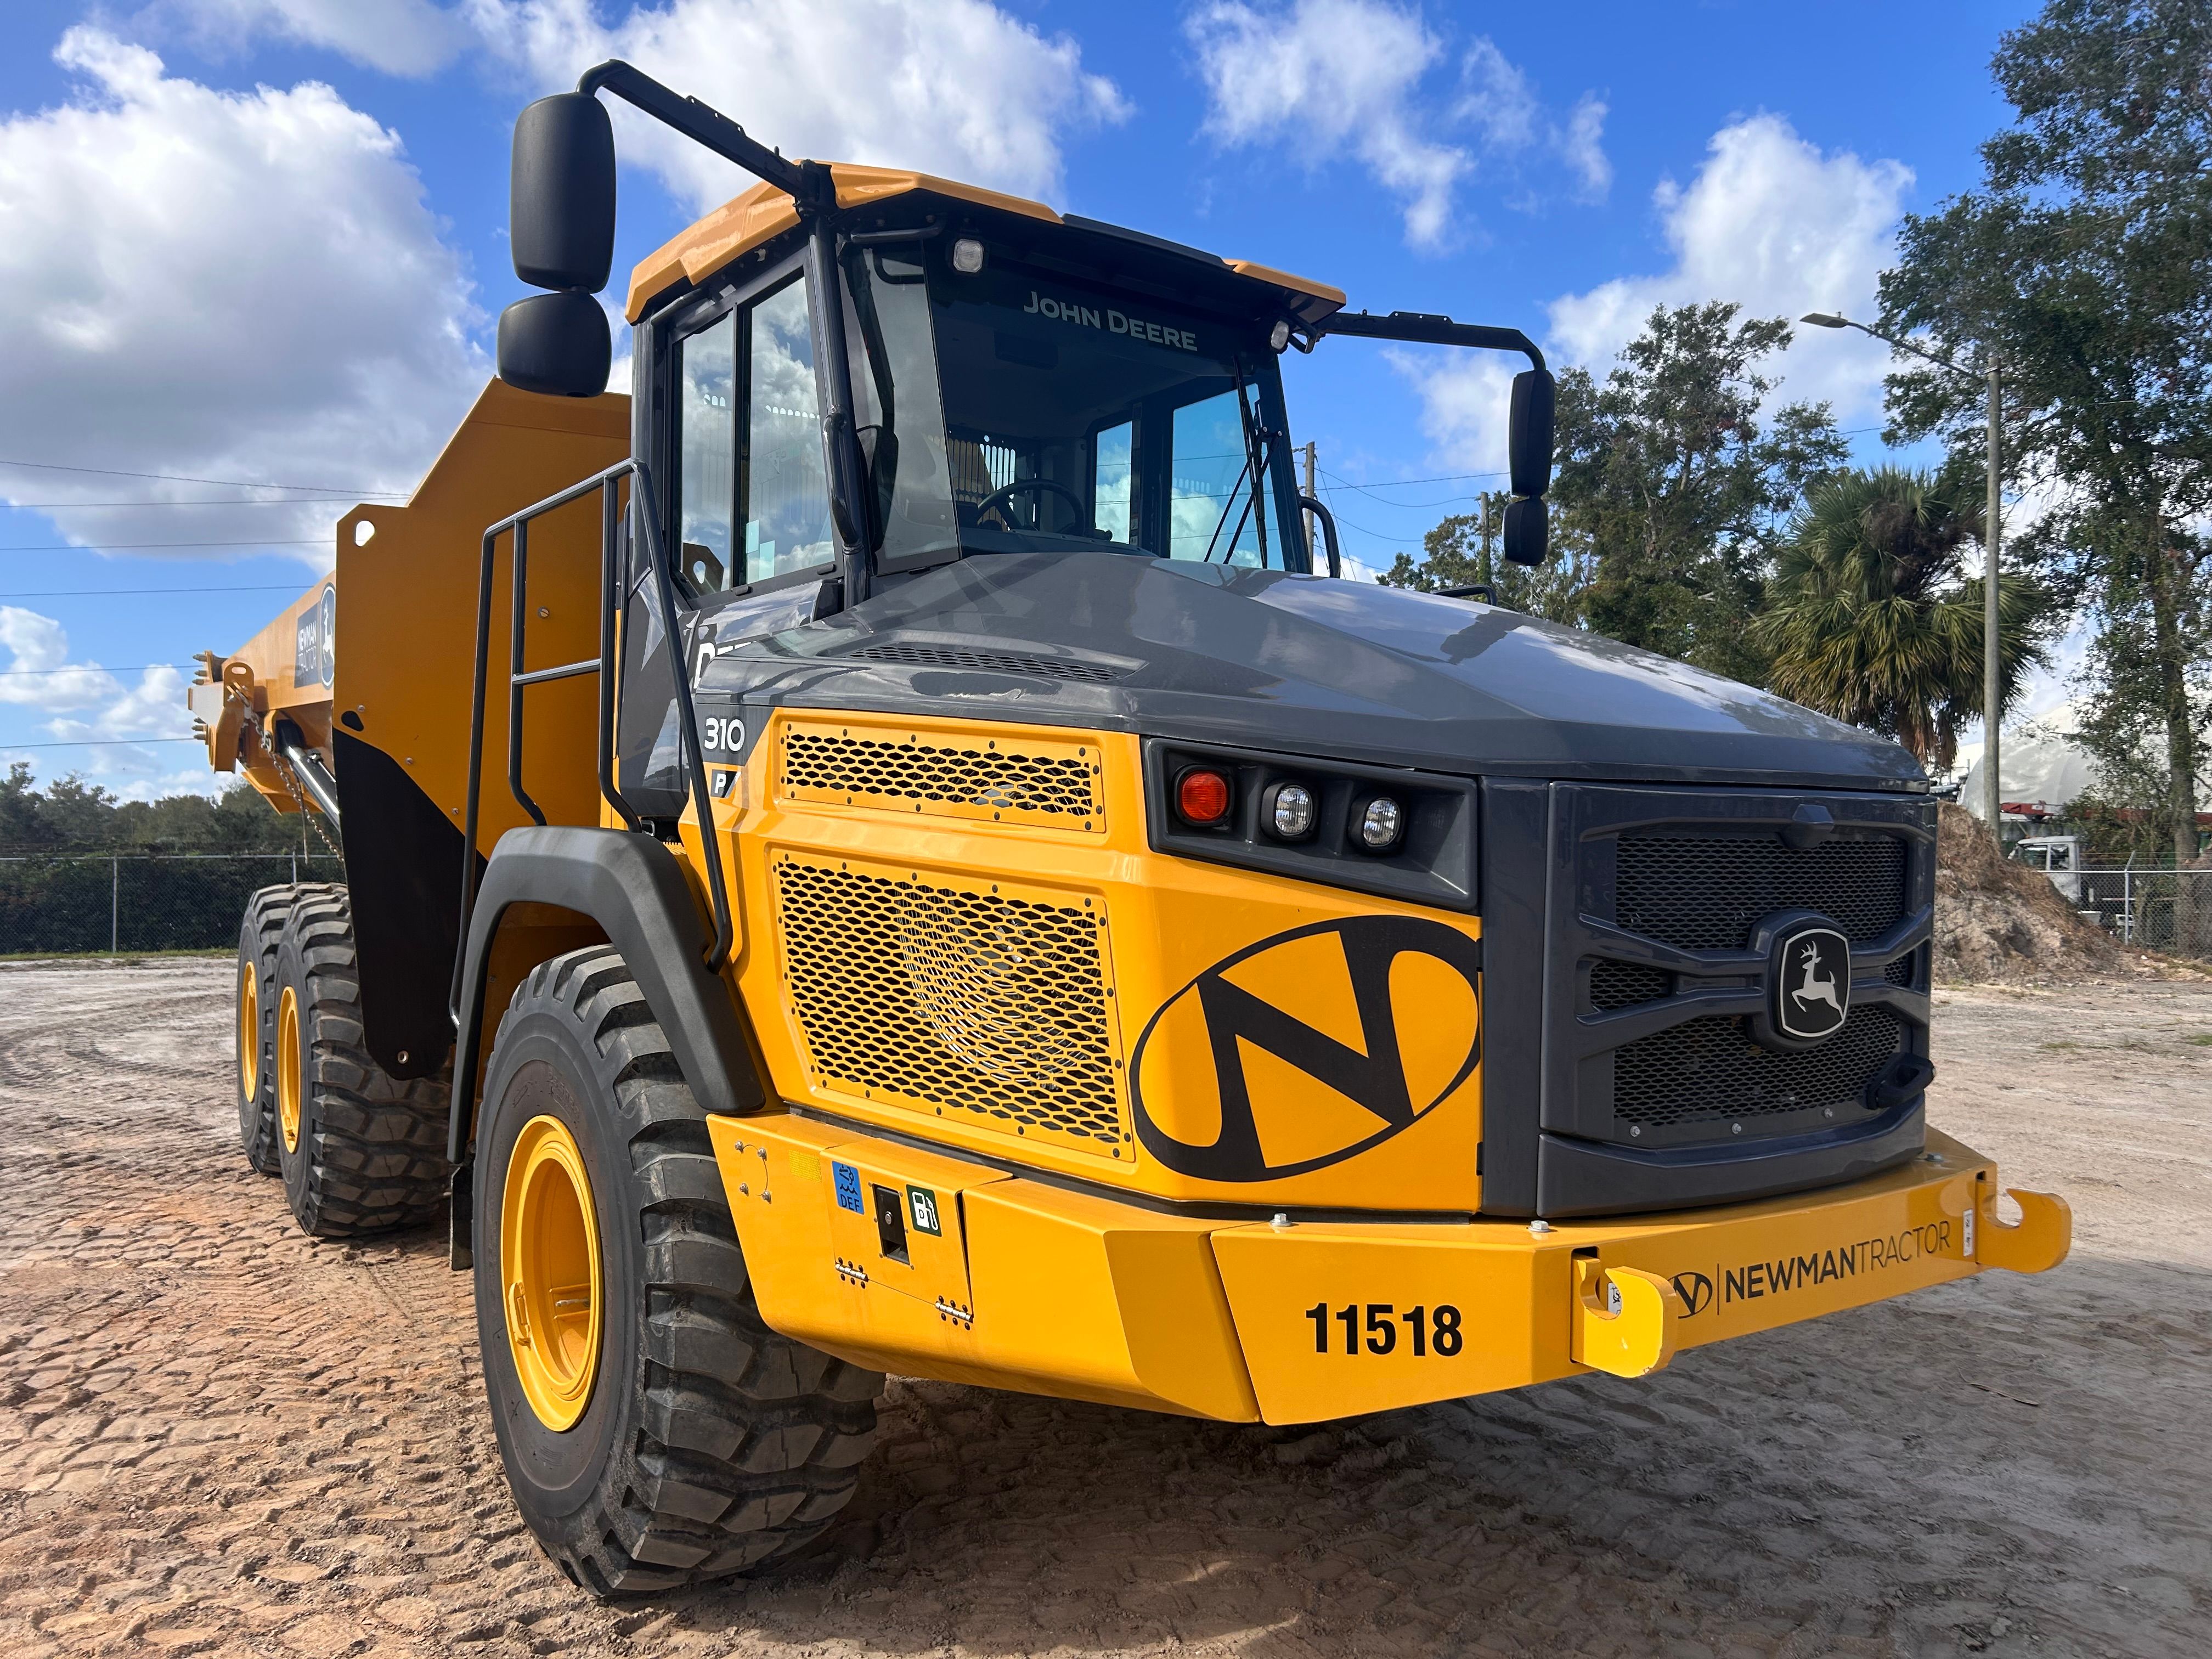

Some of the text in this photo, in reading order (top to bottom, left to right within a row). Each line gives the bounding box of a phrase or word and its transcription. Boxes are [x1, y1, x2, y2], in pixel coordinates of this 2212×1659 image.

[1024, 291, 1198, 352] JOHN DEERE
[704, 718, 745, 752] 310
[714, 773, 726, 794] P
[840, 1194, 860, 1212] DEF
[918, 1209, 924, 1219] D
[1306, 1302, 1463, 1357] 11518
